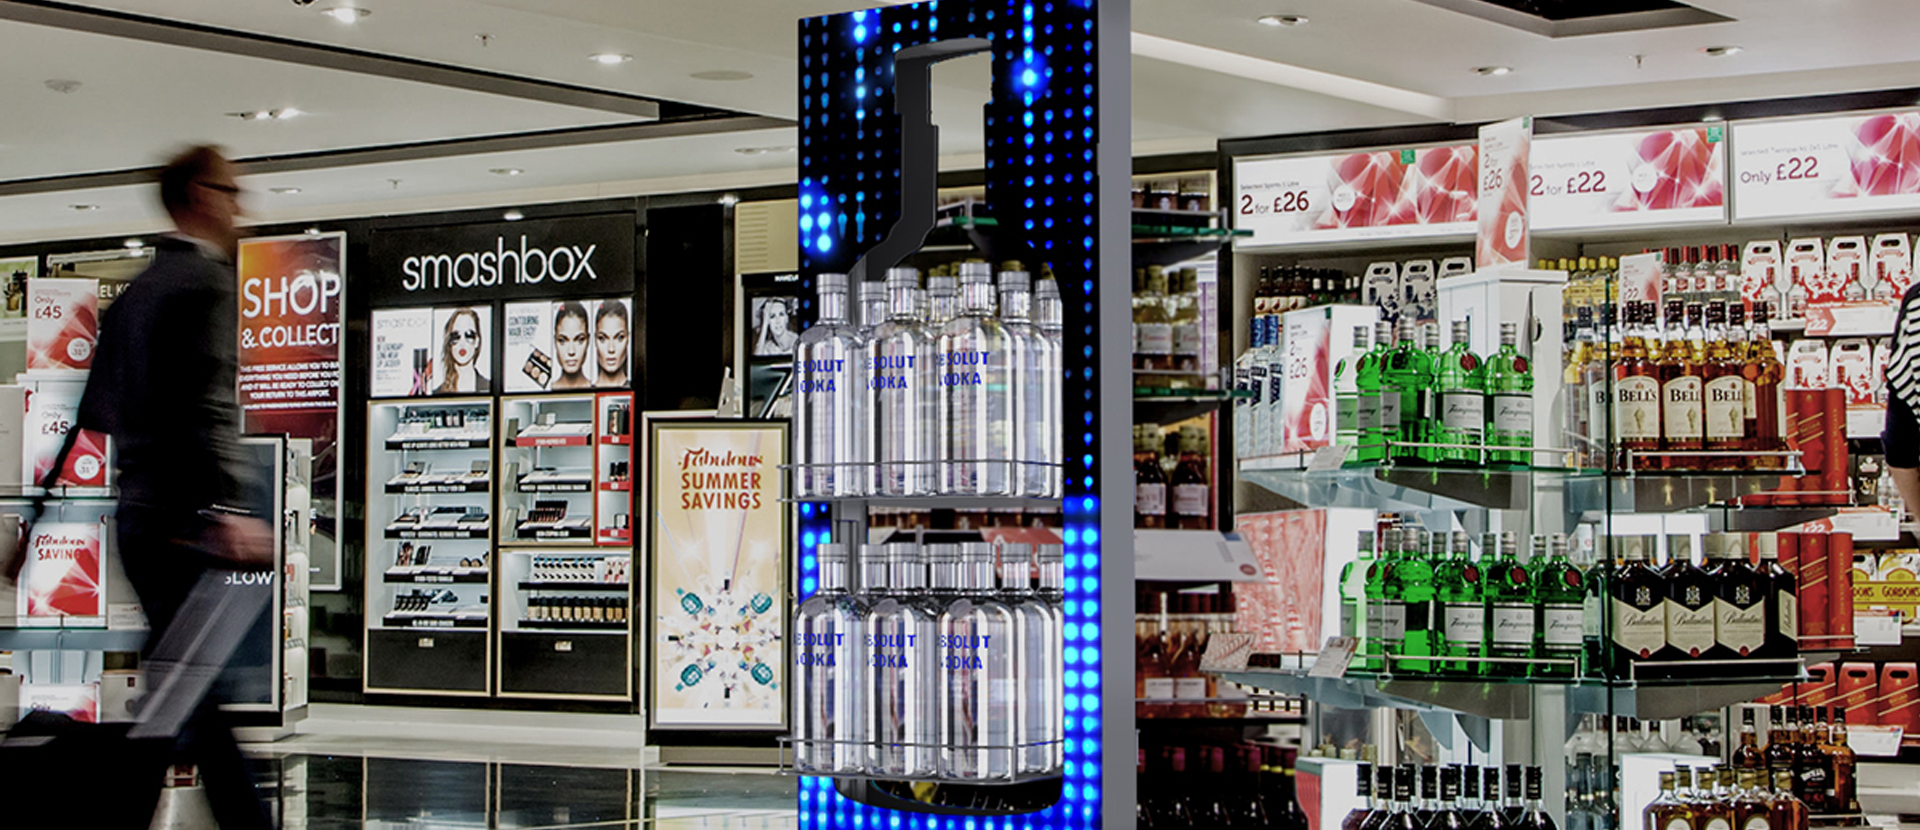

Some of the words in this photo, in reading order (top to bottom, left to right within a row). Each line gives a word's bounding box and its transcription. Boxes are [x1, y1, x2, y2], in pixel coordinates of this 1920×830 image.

[1484, 153, 1490, 168] 2
[1740, 170, 1771, 185] Only
[1776, 156, 1819, 180] £22
[1484, 168, 1502, 192] £26
[1530, 174, 1544, 196] 2
[1546, 185, 1562, 196] for
[1567, 170, 1606, 194] £22
[1241, 194, 1254, 215] 2
[1255, 204, 1270, 214] for
[1273, 190, 1310, 214] £26
[402, 234, 597, 291] smashbox
[35, 296, 55, 305] Only
[242, 273, 341, 318] SHOP
[35, 305, 62, 319] £45
[241, 328, 260, 349] &
[260, 323, 341, 348] COLLECT
[796, 379, 836, 392] ODKA
[866, 376, 908, 390] ODKA
[939, 372, 982, 386] ODKA
[42, 411, 62, 420] Only
[42, 420, 70, 435] £45
[677, 447, 763, 471] Fabulous
[681, 472, 762, 490] SUMMER
[681, 492, 762, 510] SAVINGS
[796, 652, 836, 666] ODKA
[866, 654, 908, 668] ODKA
[940, 655, 982, 670] ODKA
